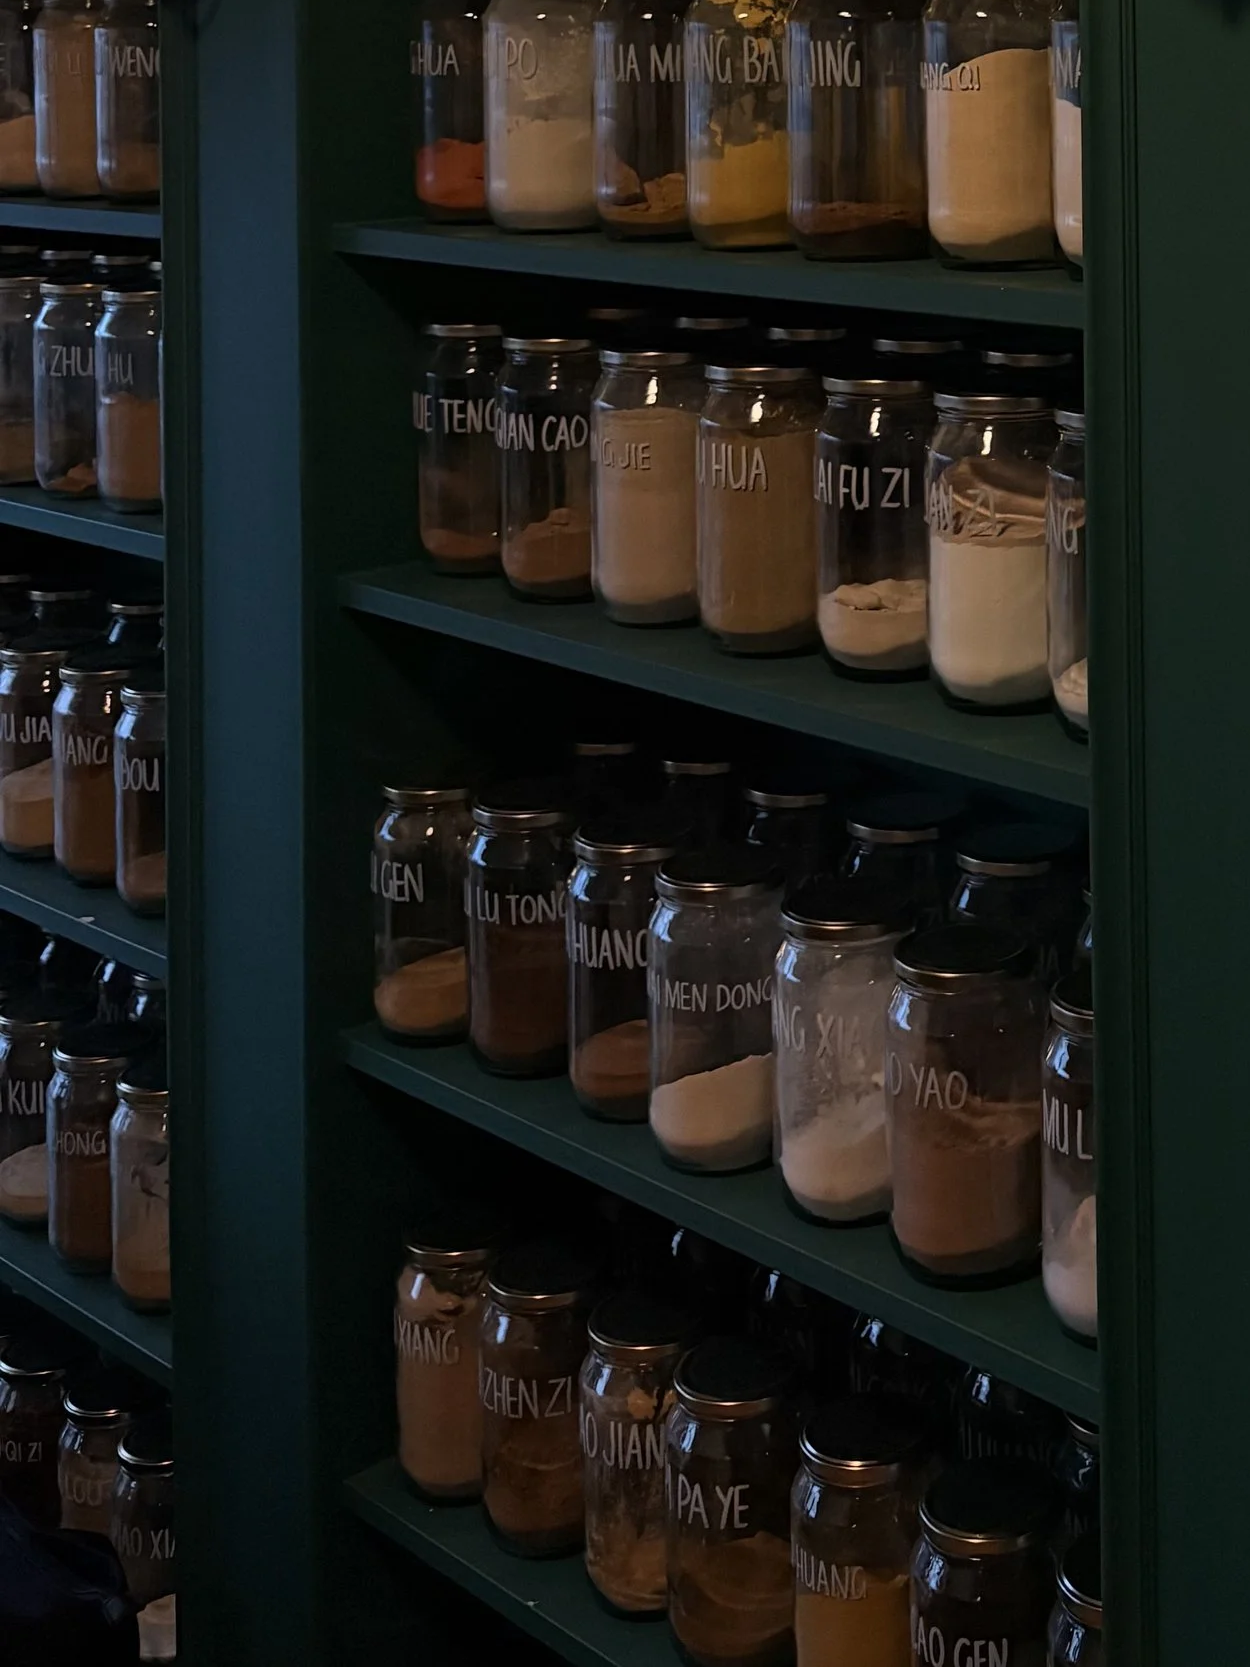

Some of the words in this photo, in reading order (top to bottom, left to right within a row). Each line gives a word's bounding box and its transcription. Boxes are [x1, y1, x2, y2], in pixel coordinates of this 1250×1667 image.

[541, 414, 589, 453] CAO
[711, 442, 768, 492] HUA
[838, 463, 871, 511] FU
[880, 466, 911, 509] ZI
[381, 861, 424, 903] GEN
[476, 894, 500, 925] LU
[664, 977, 708, 1014] MEN
[909, 1064, 969, 1111] YAO
[544, 1377, 573, 1418] ZI
[677, 1473, 710, 1530] PA
[715, 1484, 751, 1531] YE
